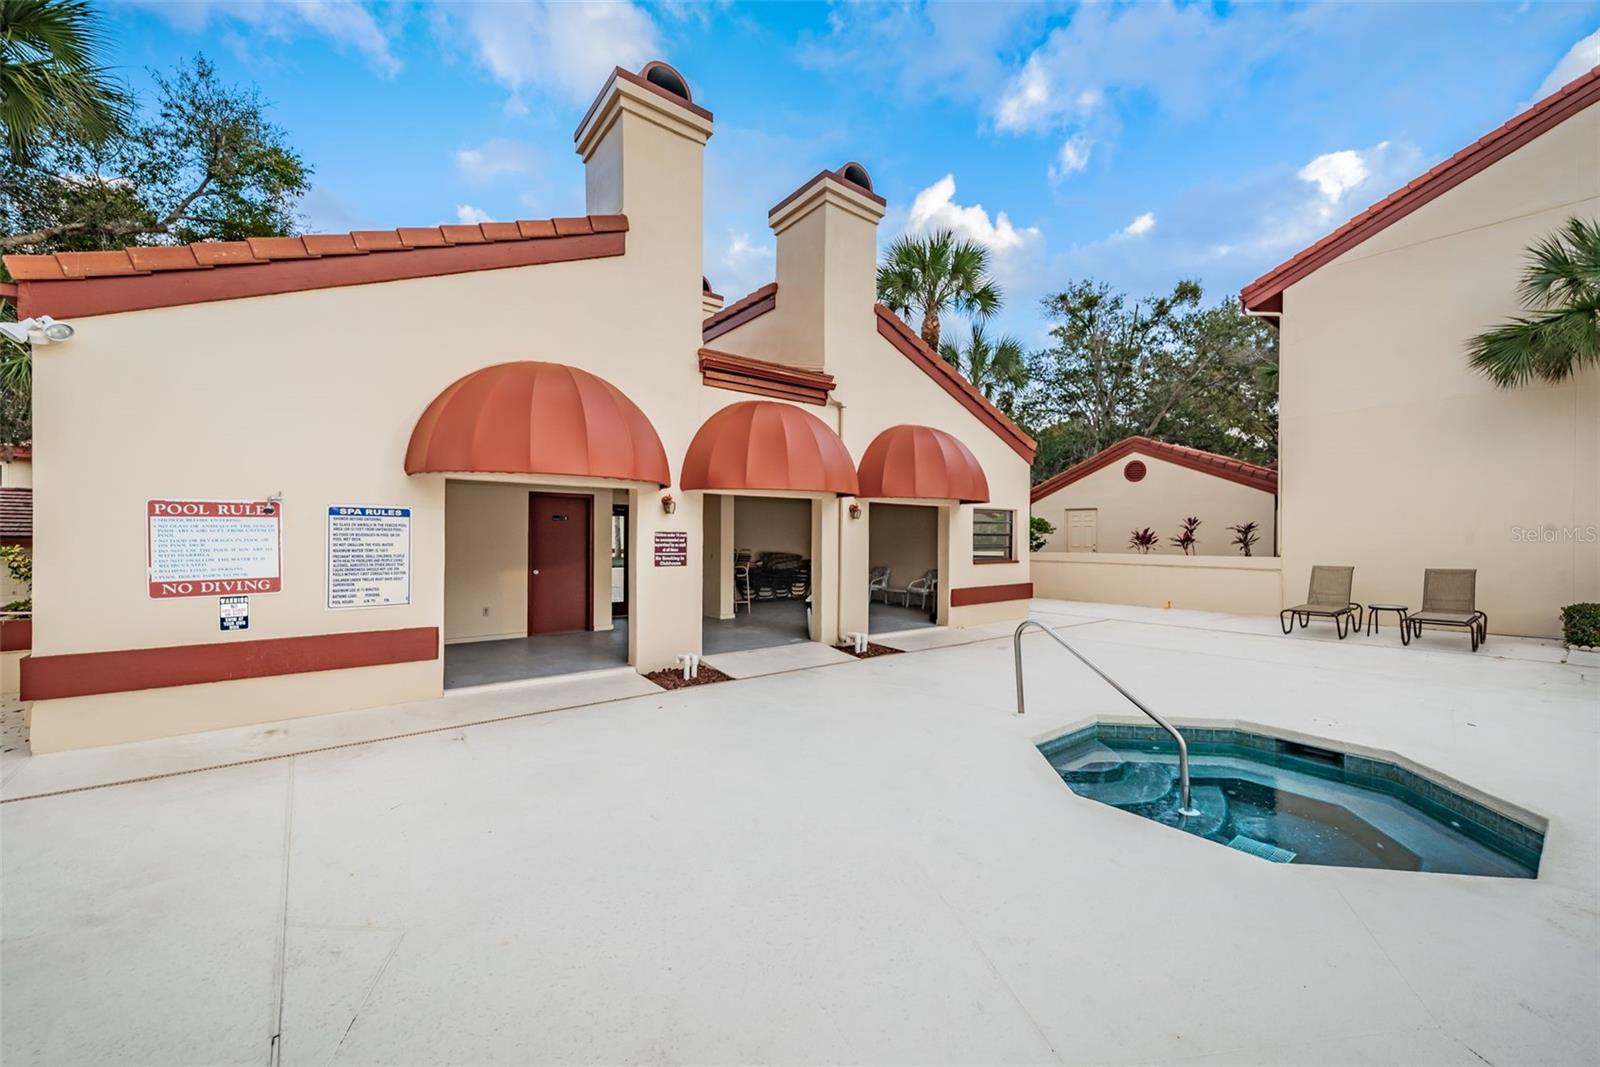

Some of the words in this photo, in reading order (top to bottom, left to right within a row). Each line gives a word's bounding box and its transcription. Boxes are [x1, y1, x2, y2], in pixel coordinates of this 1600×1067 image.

[154, 504, 209, 514] POOL
[162, 583, 192, 594] NO
[201, 580, 270, 592] DIVING
